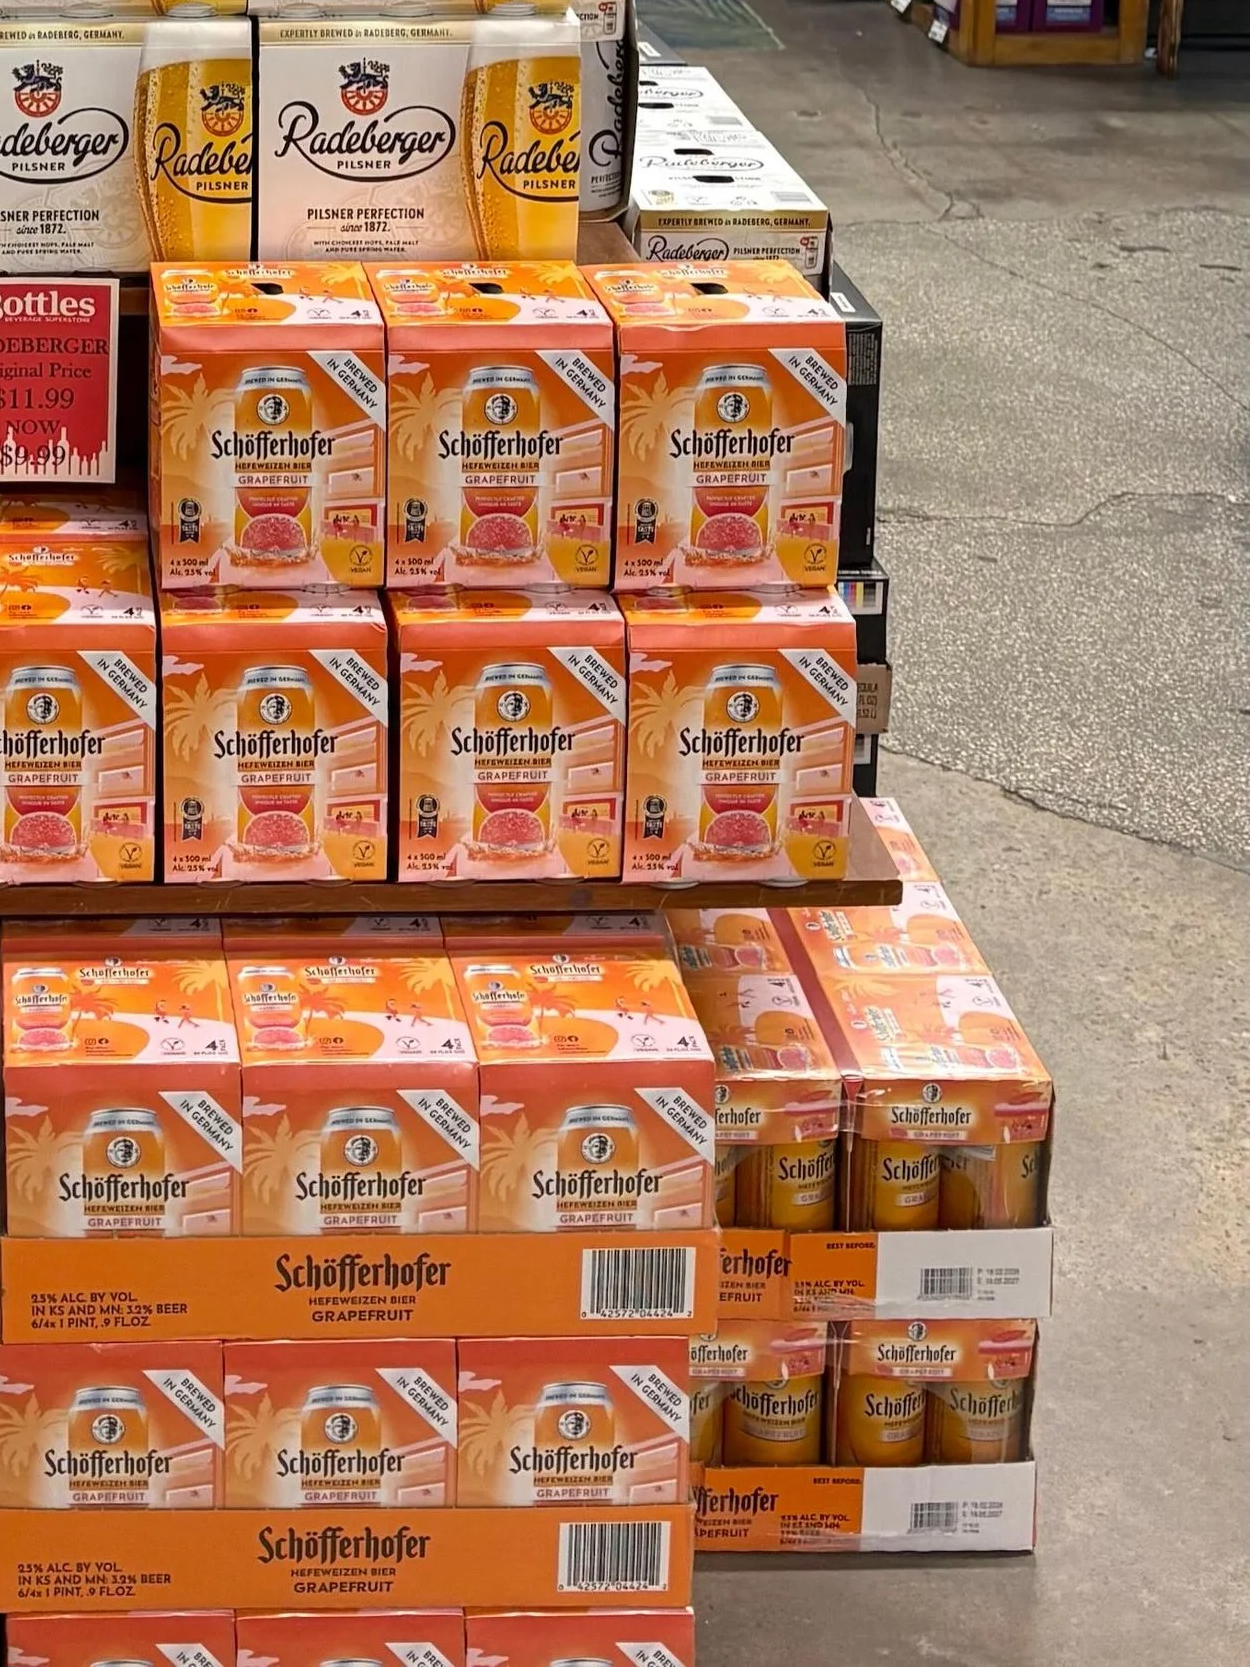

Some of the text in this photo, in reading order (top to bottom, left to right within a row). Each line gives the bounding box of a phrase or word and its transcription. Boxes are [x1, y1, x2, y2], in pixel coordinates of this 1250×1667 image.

[275, 101, 446, 164] Radeberger
[49, 363, 92, 379] Price
[343, 358, 378, 394] BREWED
[336, 367, 378, 410] GERMANY
[6, 419, 59, 435] NOW
[0, 444, 66, 467] $9.99
[211, 430, 335, 459] Schöfferhofer
[438, 428, 564, 458] Schöfferhofer
[670, 427, 794, 458] Schöfferhofer
[235, 461, 312, 470] HEFEWEIZEN BIER
[238, 475, 308, 485] GRAPEFRUIT
[214, 729, 338, 758] Schöfferhofer
[451, 726, 576, 756] Schöfferhofer
[679, 726, 804, 756] Schöfferhofer
[8, 773, 79, 785] GRAPEFRUIT
[891, 1106, 971, 1126] Schöfferhofer
[59, 1172, 190, 1202] Schöfferhofer
[532, 1168, 664, 1200] Schöfferhofer
[275, 1252, 452, 1292] Schöfferhofer
[31, 1305, 45, 1316] IN
[50, 1305, 67, 1316] KS
[70, 1305, 96, 1315] AND
[157, 1303, 188, 1314] BEER
[90, 1293, 108, 1303] BY
[68, 1317, 98, 1329] PINT,
[877, 1344, 956, 1364] Schöfferhofer
[510, 1445, 638, 1474] Schöfferhofer
